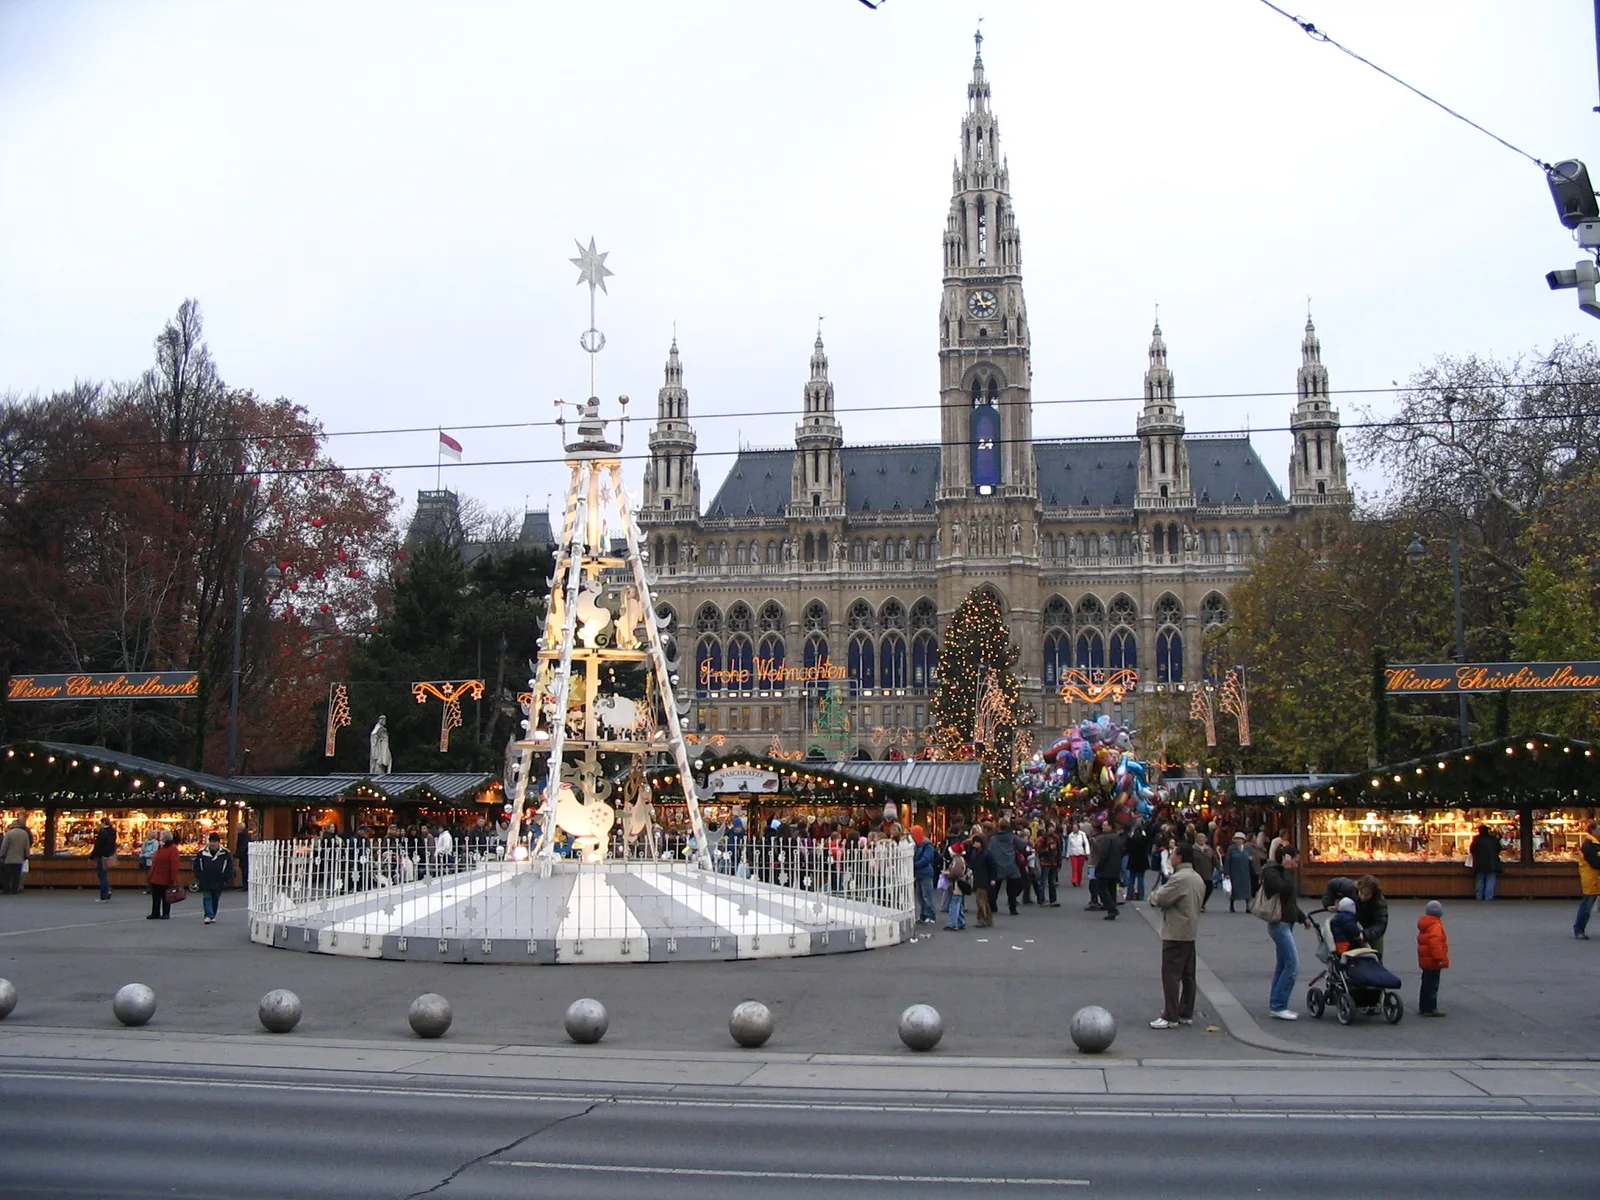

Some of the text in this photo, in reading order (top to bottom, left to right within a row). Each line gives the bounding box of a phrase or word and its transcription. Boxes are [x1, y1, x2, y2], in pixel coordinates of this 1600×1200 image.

[978, 438, 993, 450] 24
[700, 654, 846, 685] Frohe Weihnachten
[1384, 667, 1450, 690] Wiener
[8, 678, 62, 698] Wiener
